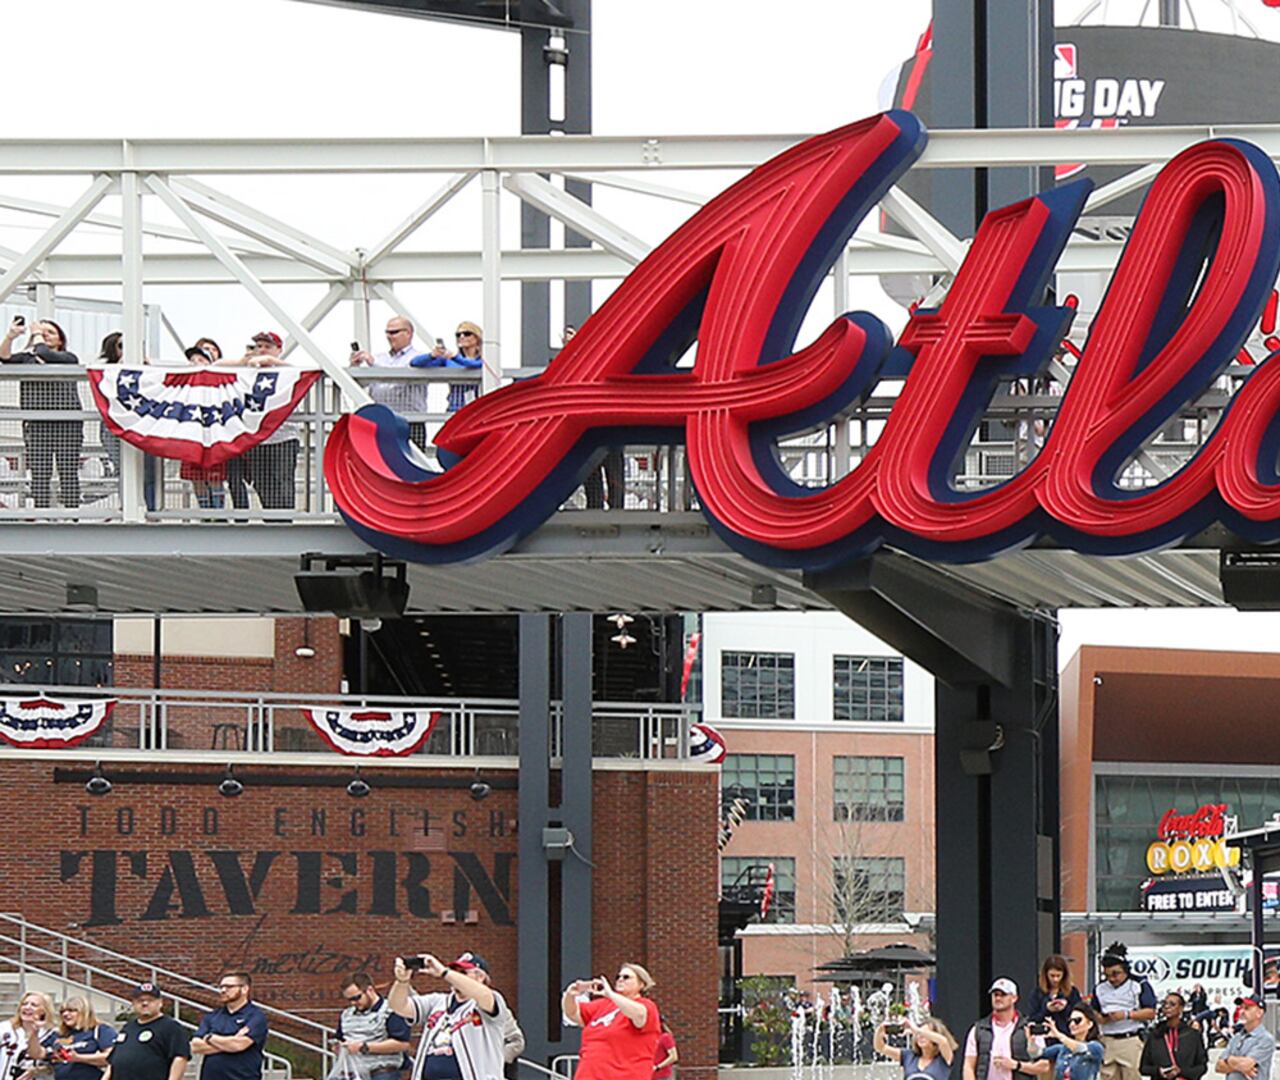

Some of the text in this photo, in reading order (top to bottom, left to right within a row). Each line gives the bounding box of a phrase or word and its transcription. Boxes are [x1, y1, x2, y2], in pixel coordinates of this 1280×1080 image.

[1093, 79, 1165, 117] DAY
[76, 806, 506, 837] TODD ENGLISH
[60, 850, 518, 928] TAVERN
[1148, 889, 1234, 910] FREE TO ENTER
[1175, 958, 1250, 979] SOUTH
